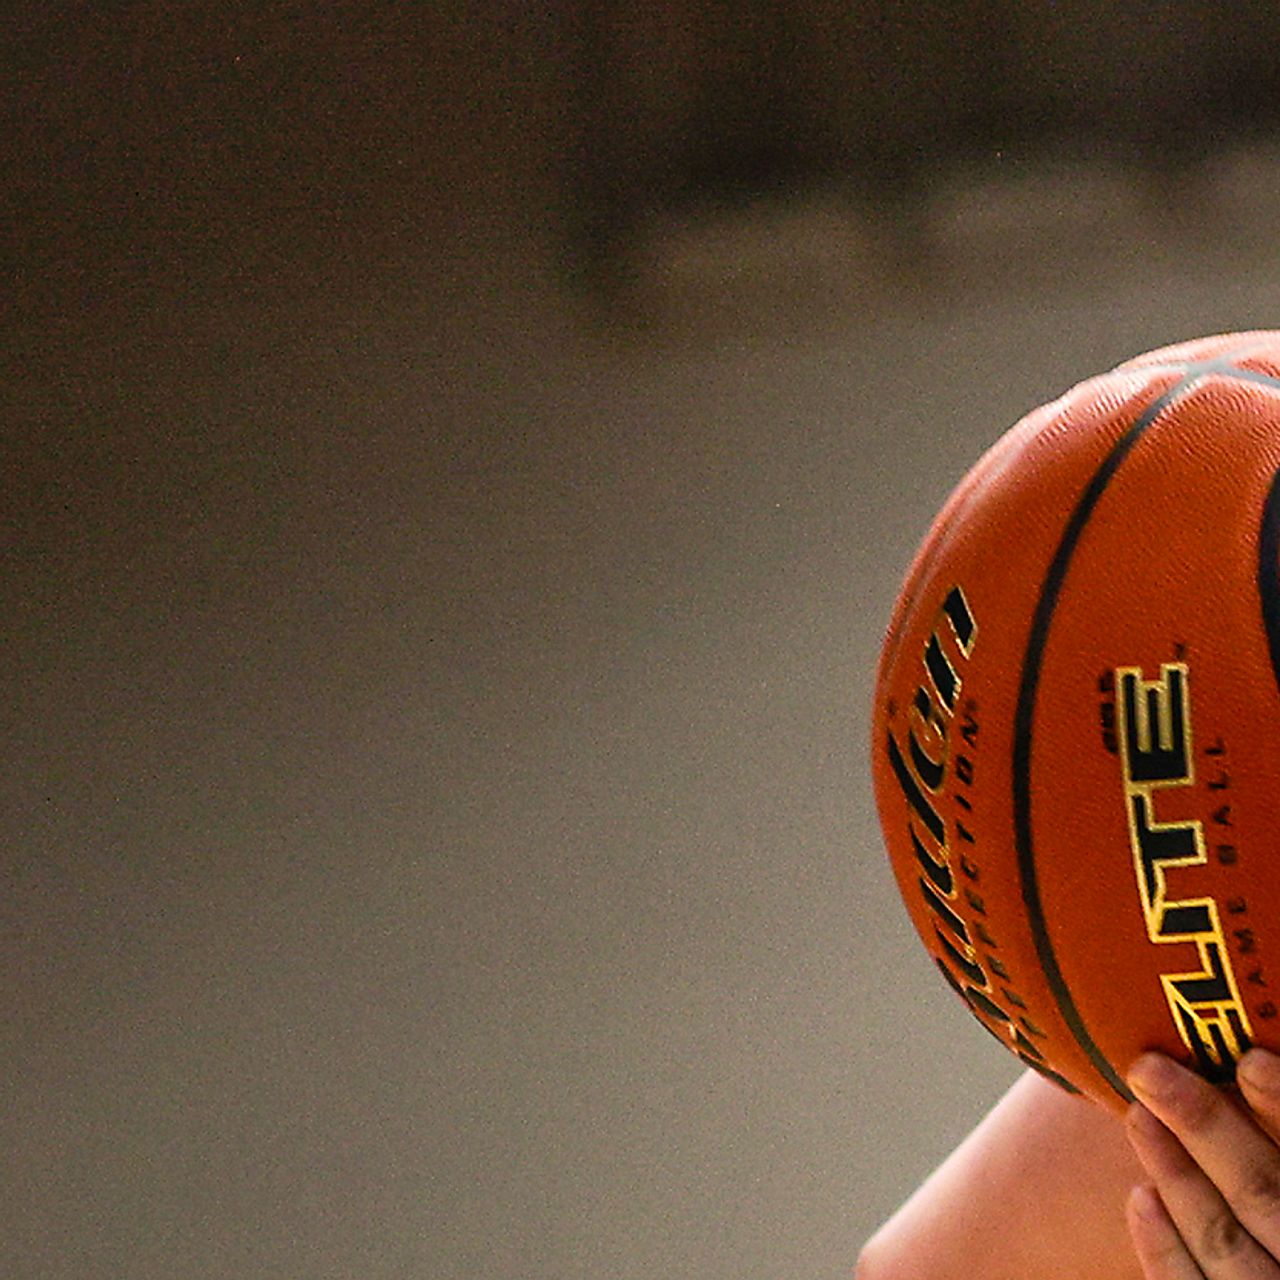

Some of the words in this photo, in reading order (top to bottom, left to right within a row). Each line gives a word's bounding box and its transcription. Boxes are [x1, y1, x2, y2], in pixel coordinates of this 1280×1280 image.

[1205, 739, 1238, 865] BALL
[1116, 663, 1253, 1082] ELITE
[1227, 896, 1278, 1020] GAME
